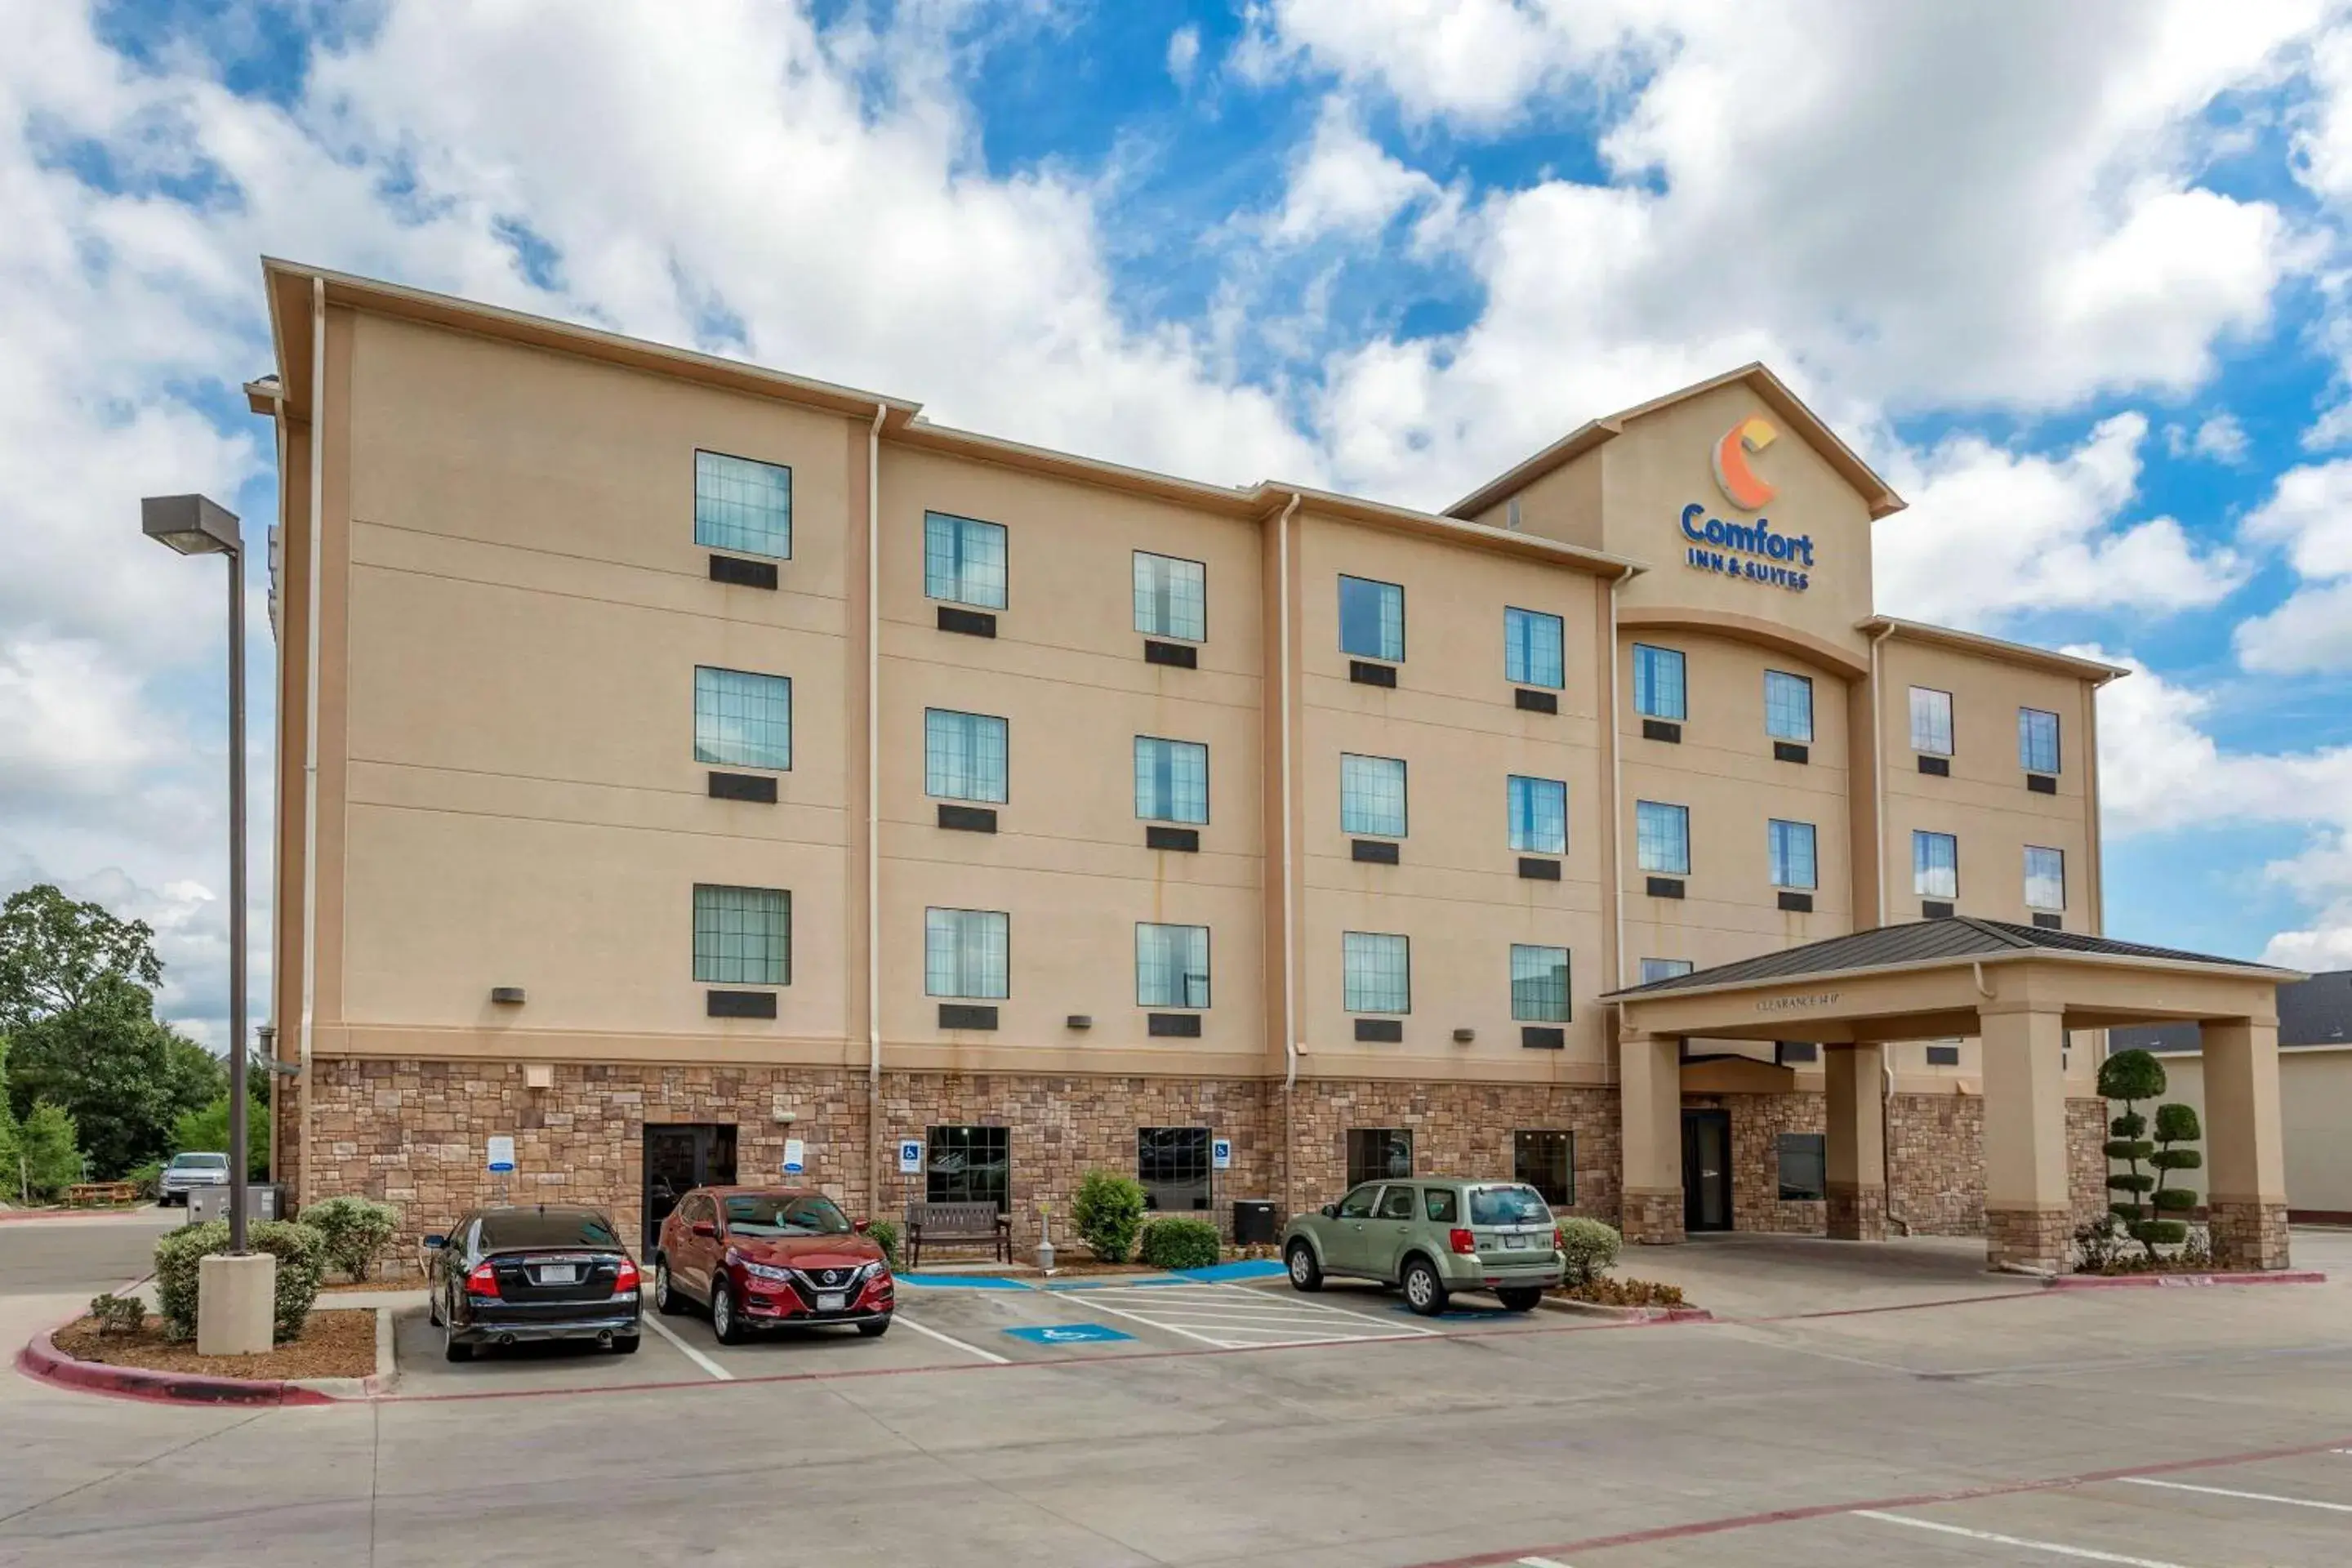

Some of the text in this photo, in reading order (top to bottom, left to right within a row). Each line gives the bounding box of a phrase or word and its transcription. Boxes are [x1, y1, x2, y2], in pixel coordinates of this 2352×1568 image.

[1682, 503, 1814, 566] Comfort
[1688, 548, 1809, 590] INN & SUITES
[1756, 994, 1816, 1012] CLEARANCE
